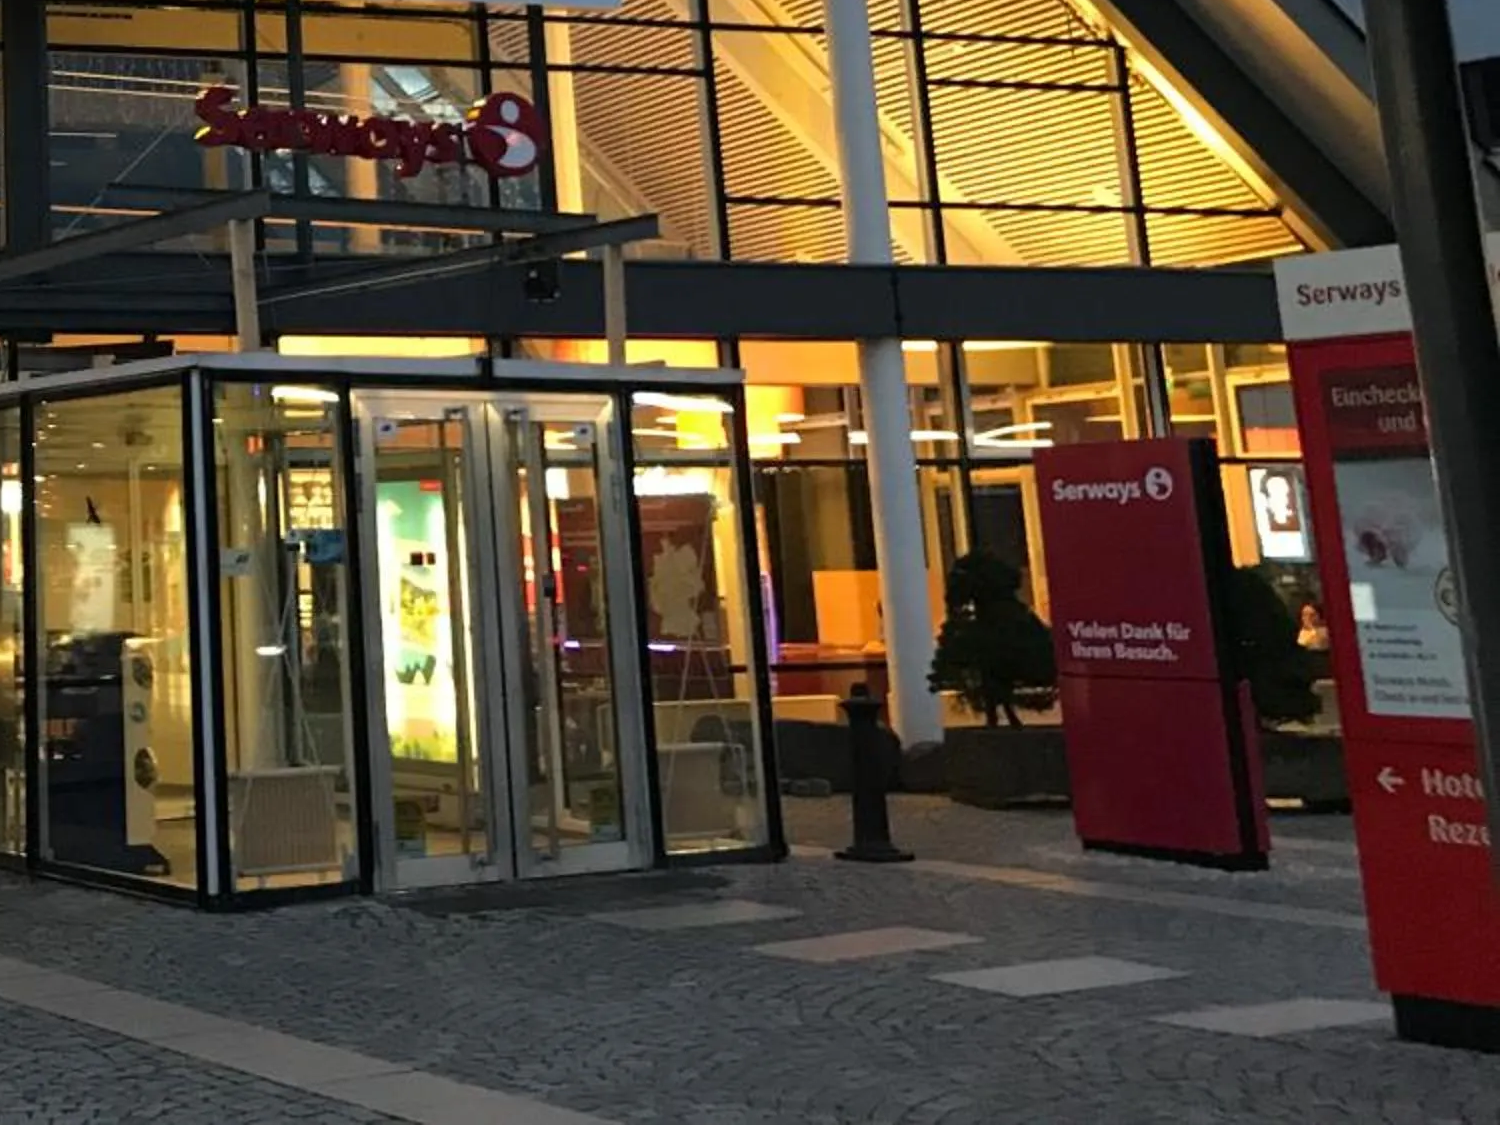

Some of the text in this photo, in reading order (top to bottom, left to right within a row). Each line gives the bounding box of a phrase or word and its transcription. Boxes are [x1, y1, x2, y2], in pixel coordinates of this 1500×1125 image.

[194, 85, 462, 179] Serways
[1296, 279, 1402, 306] Serways
[1330, 383, 1421, 407] Eincheck
[1378, 410, 1417, 432] und
[1052, 478, 1141, 505] Serways
[1067, 620, 1191, 641] Vielen Dank für
[1071, 641, 1179, 662] Ihren Besuch.
